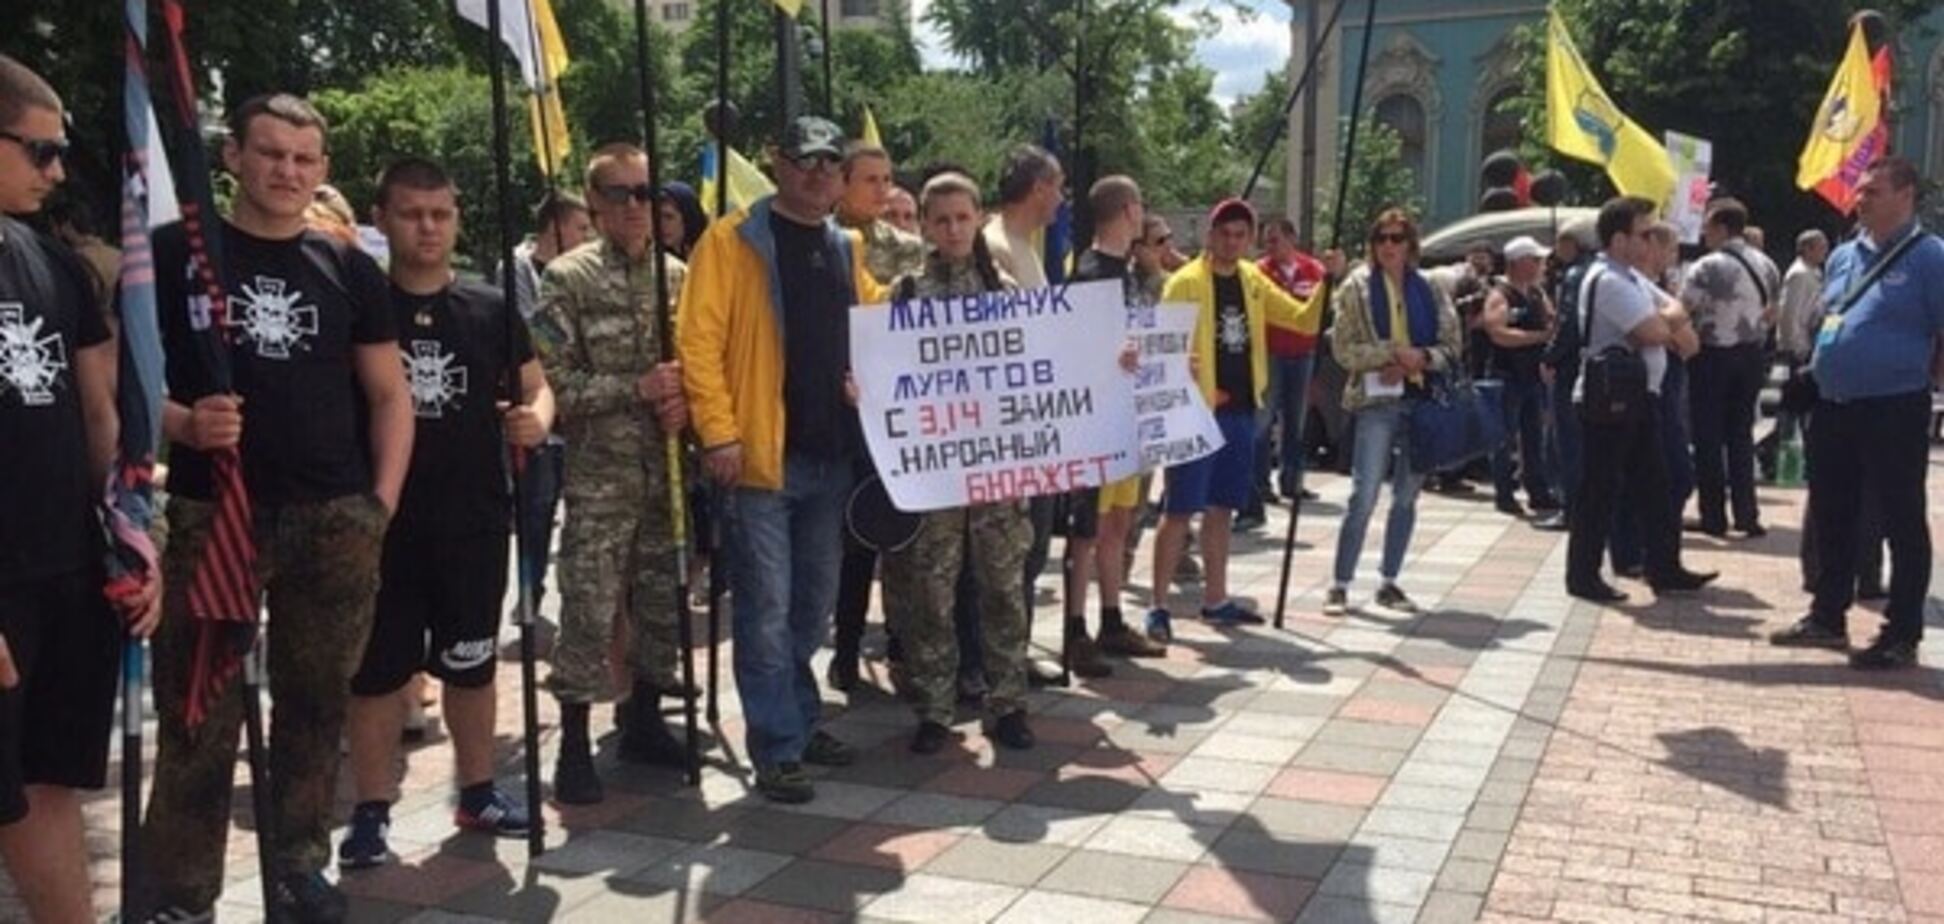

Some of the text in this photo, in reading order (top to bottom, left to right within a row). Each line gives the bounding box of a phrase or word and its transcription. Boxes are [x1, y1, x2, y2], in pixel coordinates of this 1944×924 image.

[919, 327, 1025, 364] ОРЛОВ
[894, 359, 1055, 399] МУРАТОВ
[885, 408, 908, 438] С
[920, 401, 981, 437] 3,14
[999, 388, 1093, 426] ЗДИЛИ
